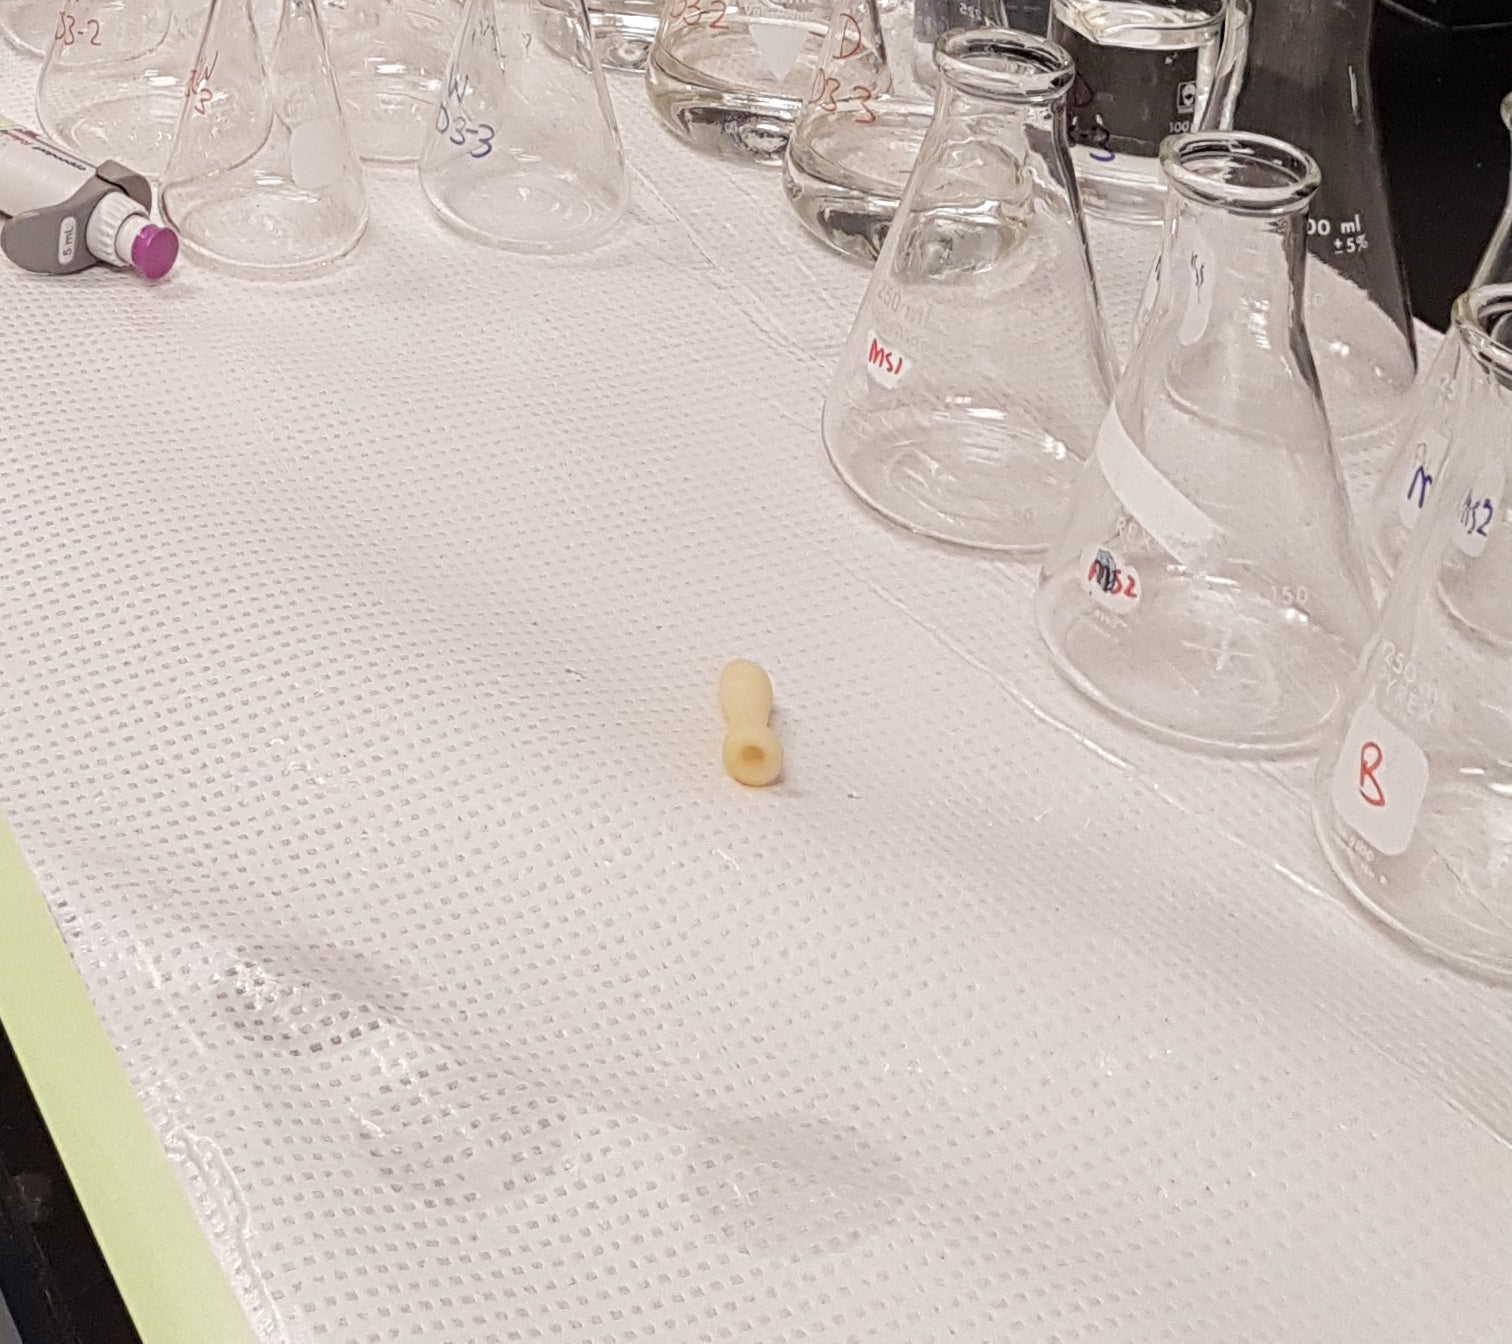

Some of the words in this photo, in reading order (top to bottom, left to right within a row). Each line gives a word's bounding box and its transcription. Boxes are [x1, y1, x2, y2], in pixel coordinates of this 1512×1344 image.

[832, 12, 862, 60] D
[1306, 217, 1332, 236] 00
[1340, 213, 1361, 234] ml
[1270, 584, 1309, 606] 150
